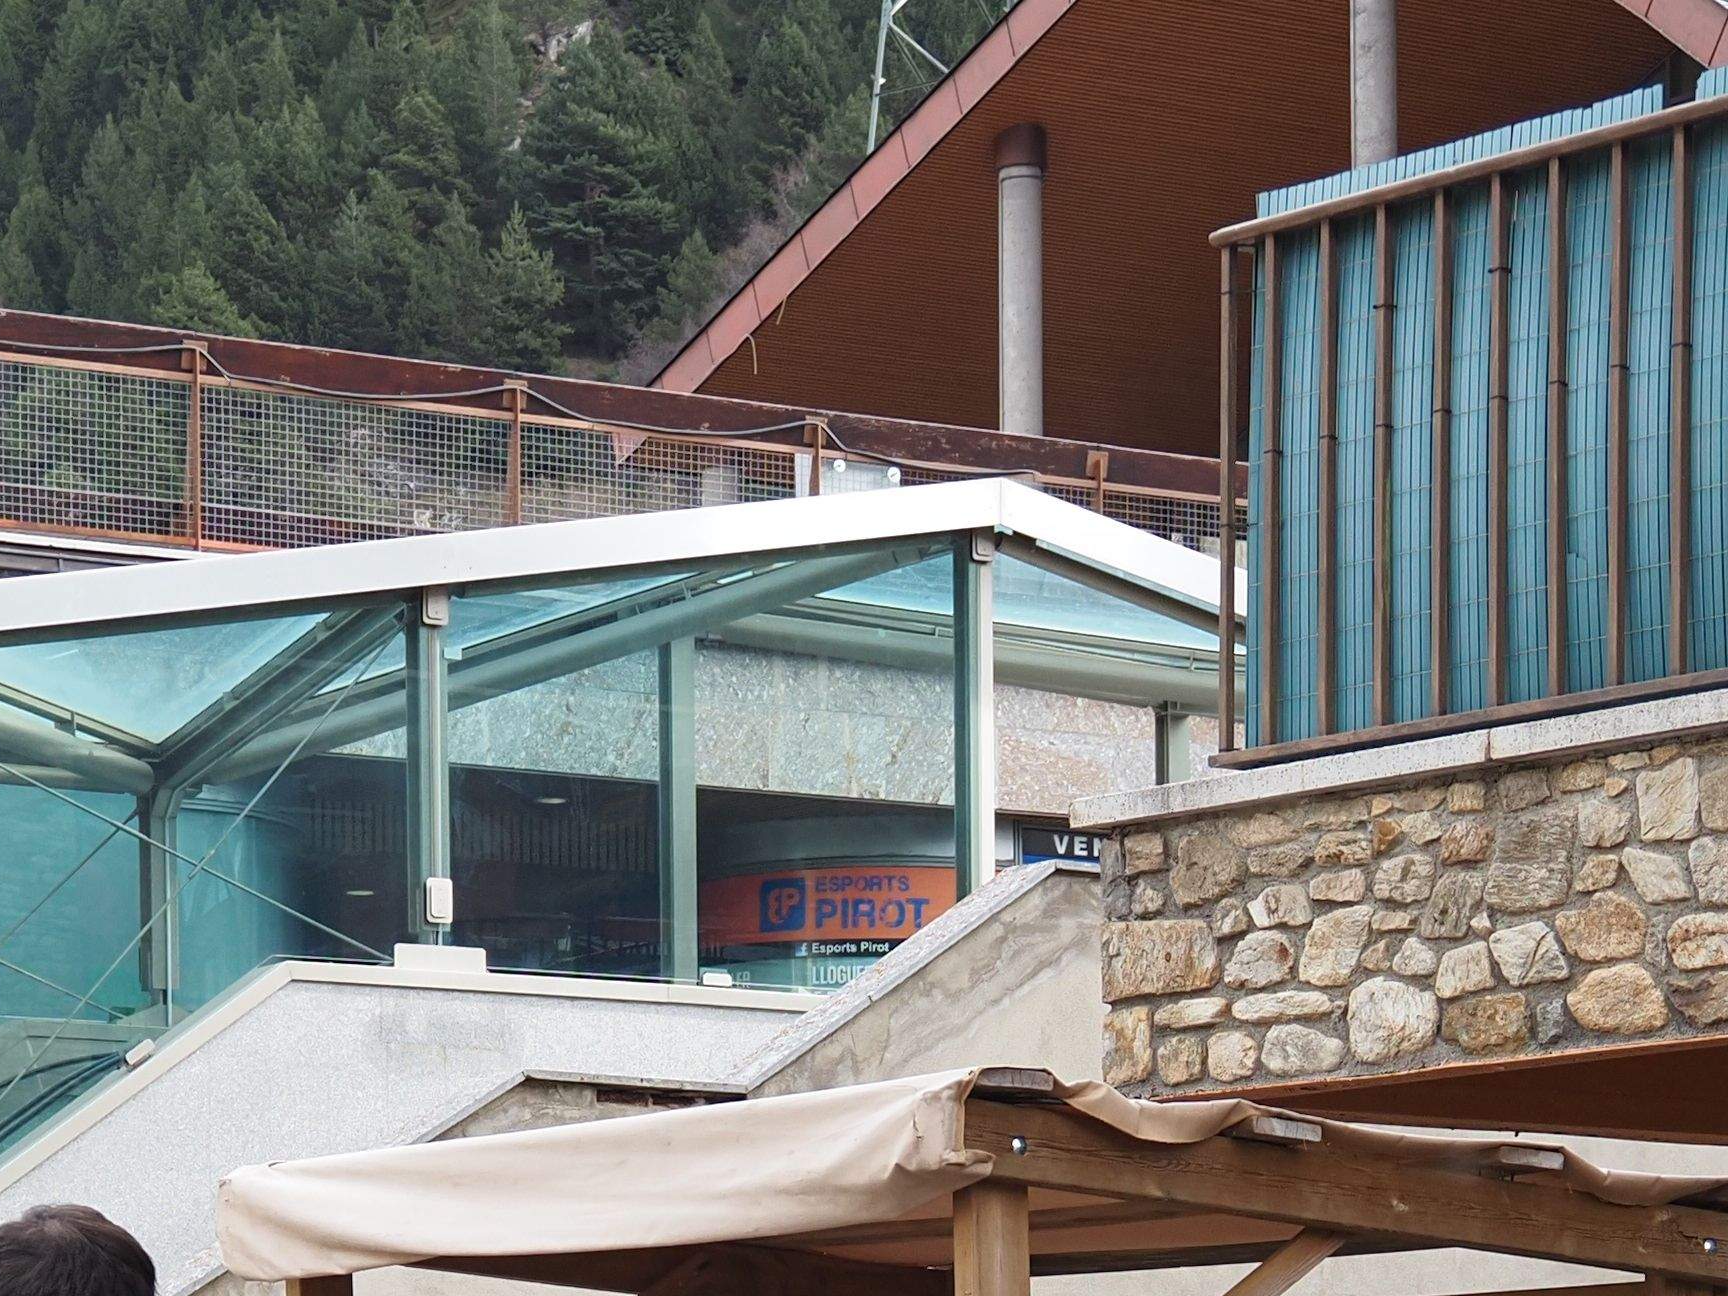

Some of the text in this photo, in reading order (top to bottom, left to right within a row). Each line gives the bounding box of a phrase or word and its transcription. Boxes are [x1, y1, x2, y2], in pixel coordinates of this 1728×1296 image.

[815, 875, 910, 892] ESPORTS
[815, 897, 930, 929] PIROT
[812, 942, 858, 955] Esports
[860, 941, 890, 953] Pirot
